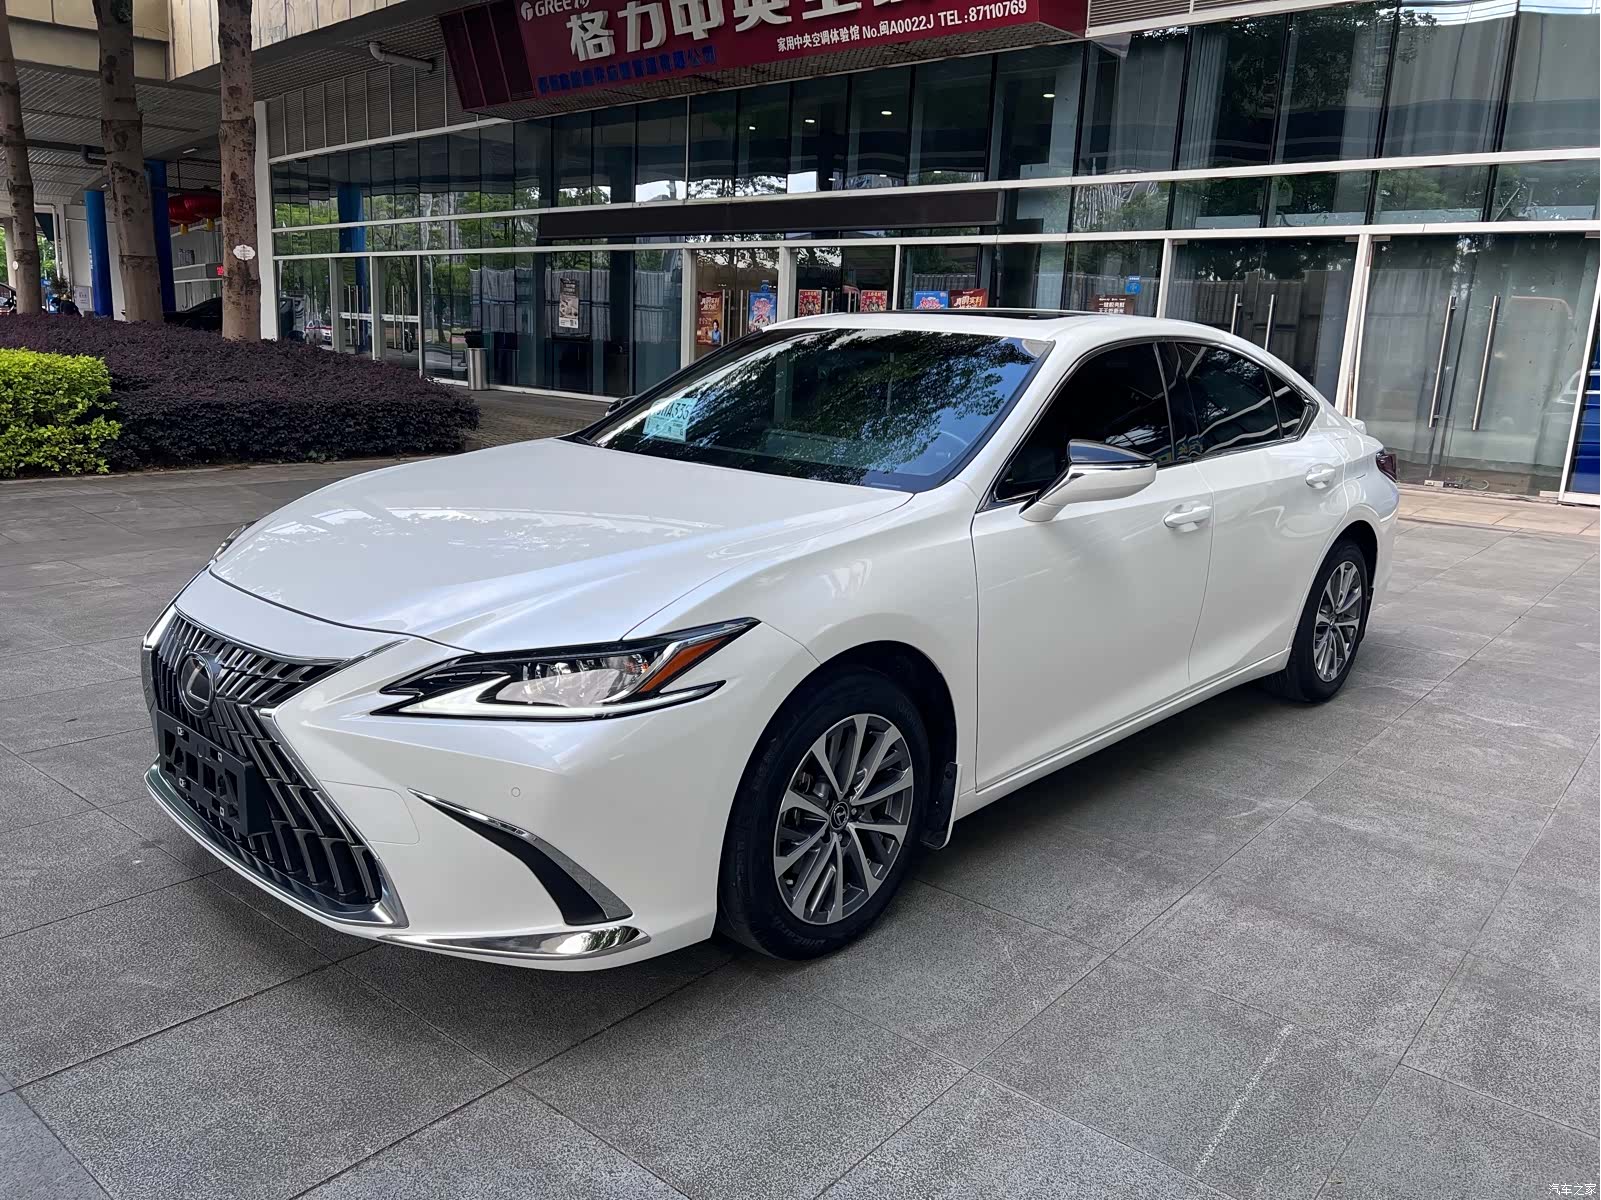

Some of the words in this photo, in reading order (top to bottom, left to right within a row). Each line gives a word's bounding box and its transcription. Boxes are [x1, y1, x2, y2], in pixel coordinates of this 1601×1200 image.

[777, 25, 860, 52] 家用中央空调体验馆
